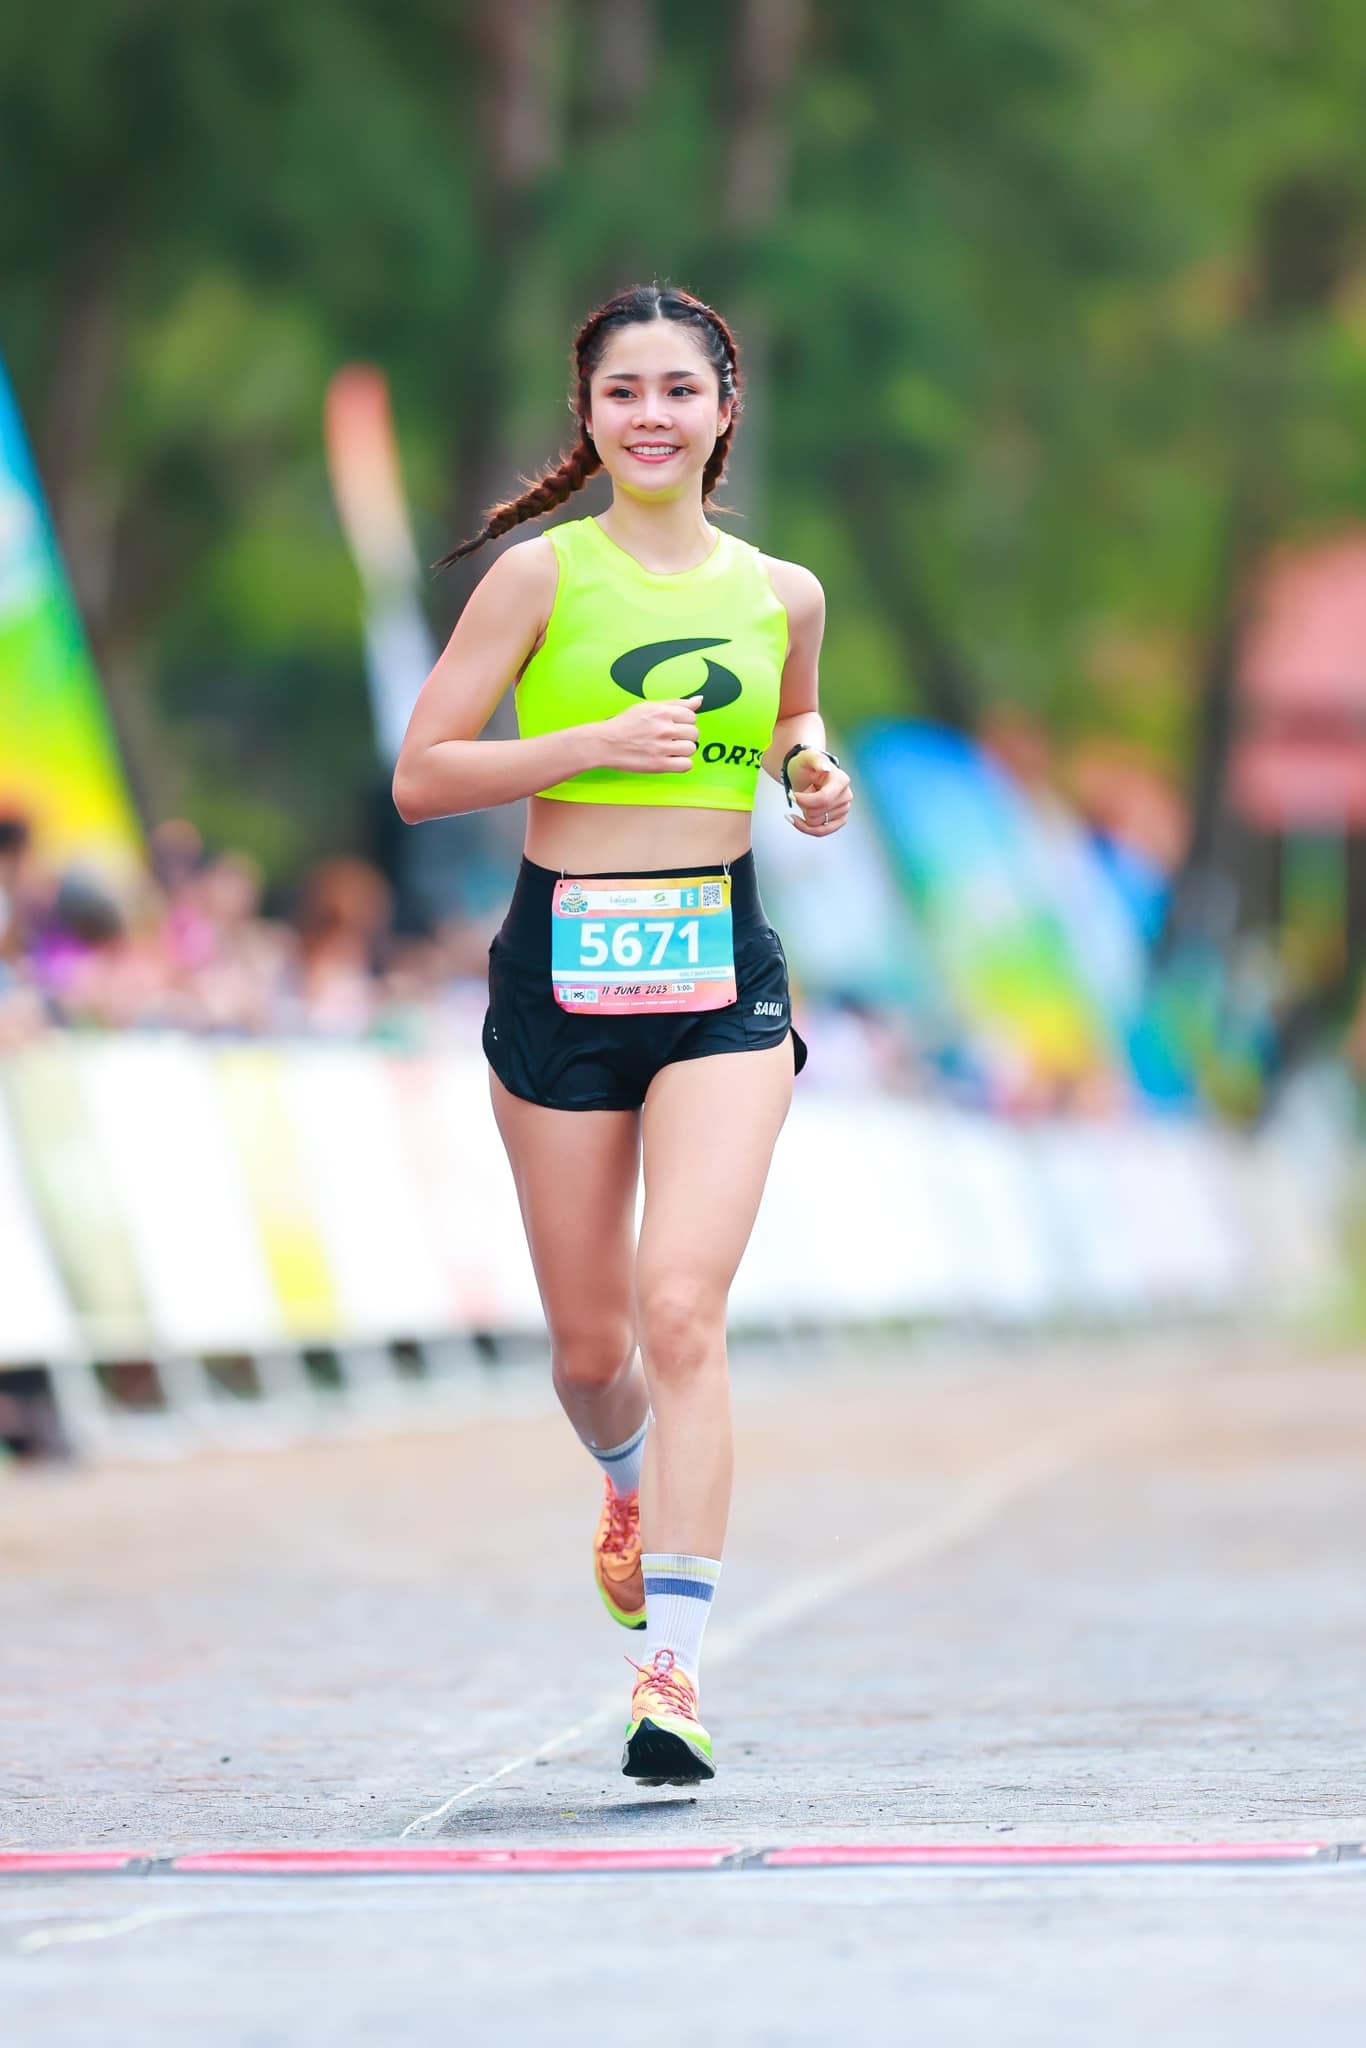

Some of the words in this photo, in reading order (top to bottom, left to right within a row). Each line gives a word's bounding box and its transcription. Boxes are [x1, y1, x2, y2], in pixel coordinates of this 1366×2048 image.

[695, 741, 763, 769] ORTS
[686, 892, 695, 906] E
[579, 920, 700, 967] 5671
[601, 986, 610, 996] 11
[614, 985, 641, 995] JUNE
[645, 984, 668, 995] 2023
[753, 1001, 783, 1017] SAKAI
